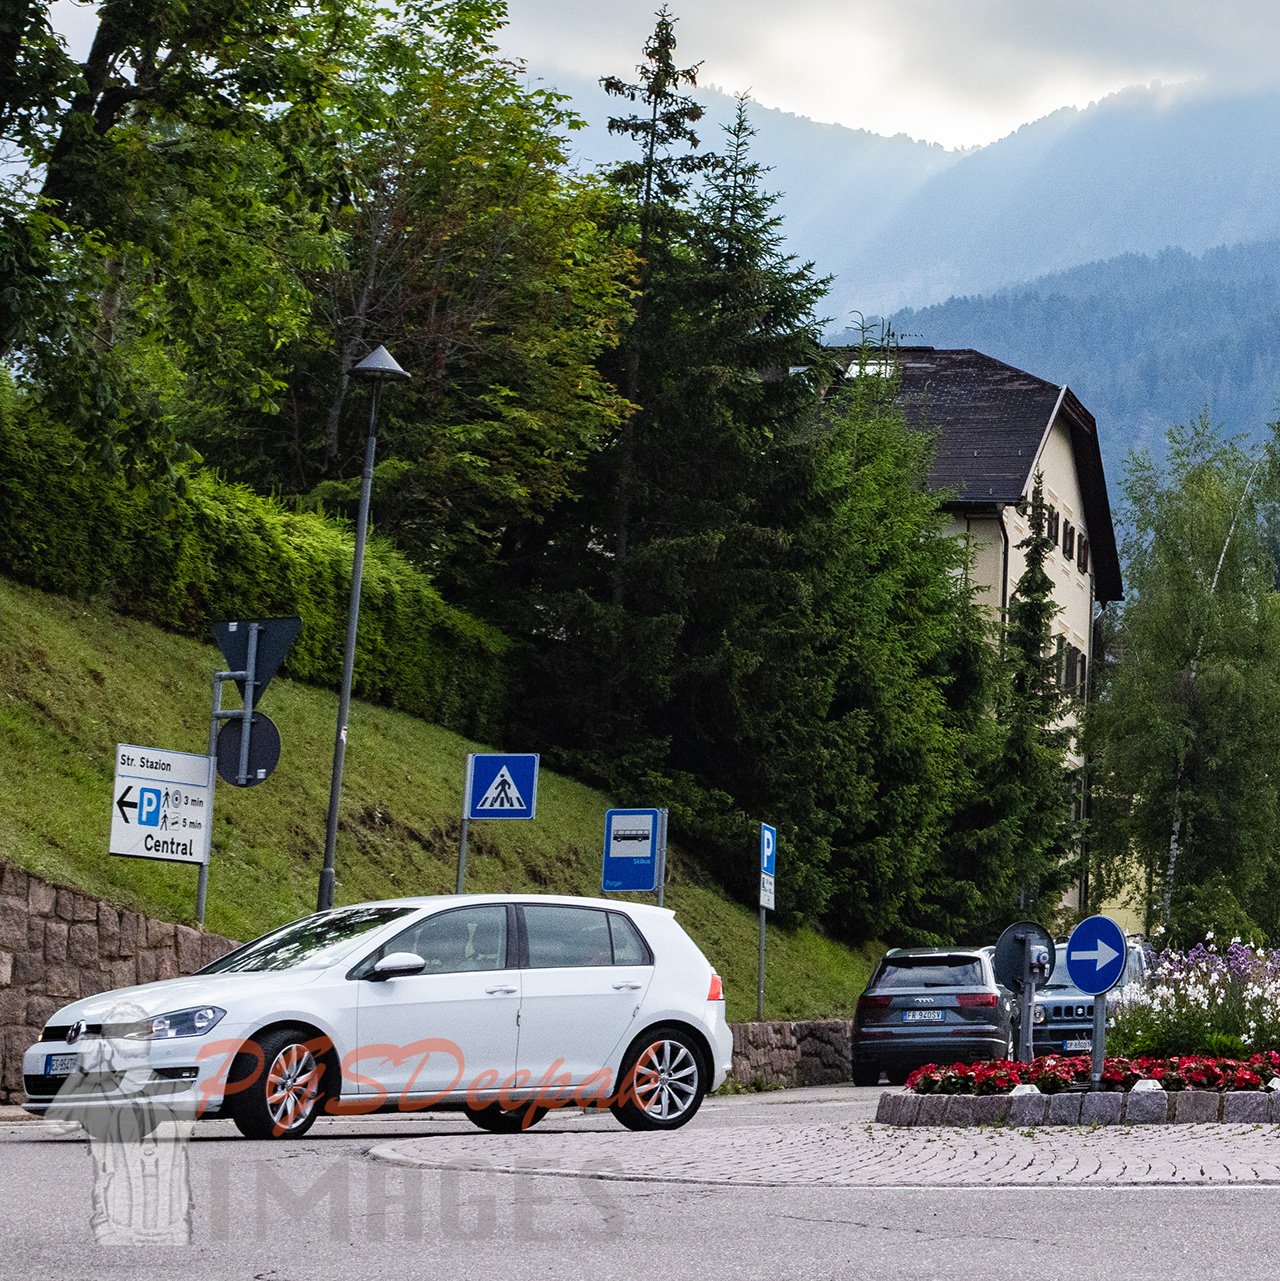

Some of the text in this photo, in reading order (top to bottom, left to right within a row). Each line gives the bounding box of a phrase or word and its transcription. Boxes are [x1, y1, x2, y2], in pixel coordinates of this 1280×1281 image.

[120, 754, 172, 772] Str. Stazion
[184, 796, 189, 805] 3
[190, 798, 204, 807] min
[182, 819, 202, 829] 5 min
[144, 834, 193, 856] Central
